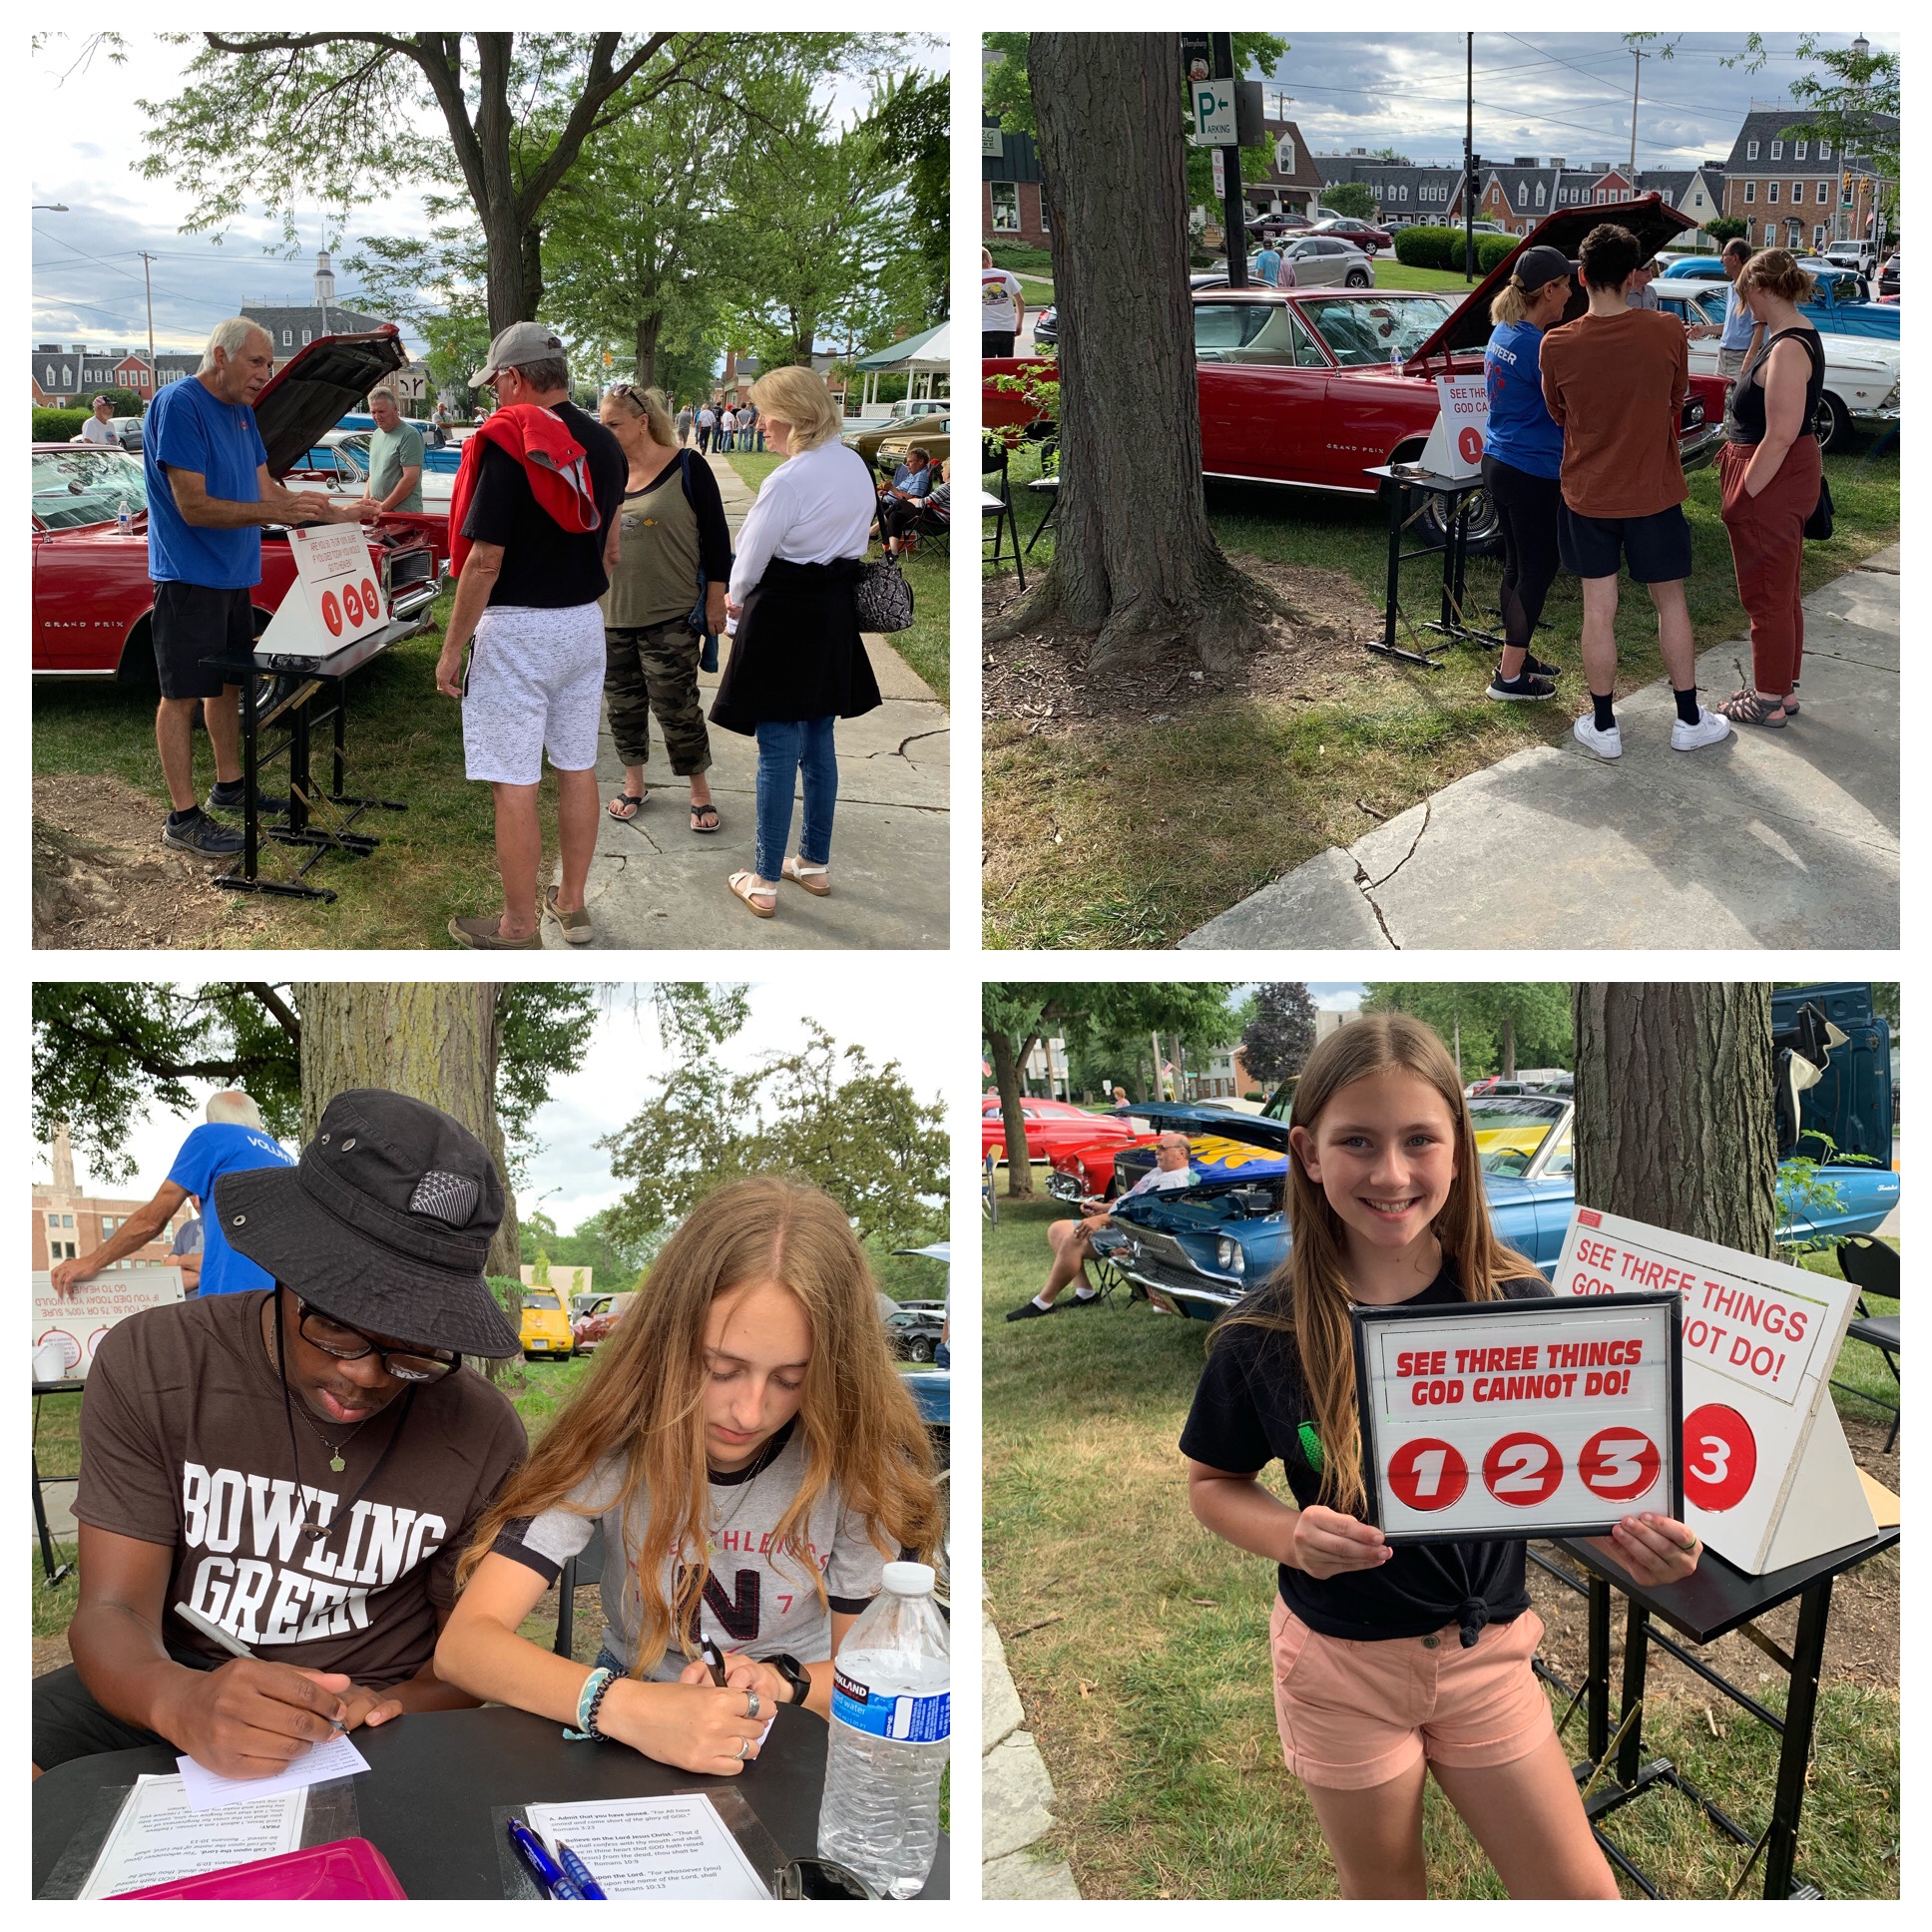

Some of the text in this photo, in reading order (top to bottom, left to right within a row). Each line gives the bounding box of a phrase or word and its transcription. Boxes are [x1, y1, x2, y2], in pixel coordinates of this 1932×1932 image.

[1450, 388, 1467, 399] SEE
[1469, 387, 1487, 398] THR
[1454, 403, 1473, 413] GOD
[1327, 443, 1357, 451] GRAND
[1467, 437, 1477, 455] 1
[329, 590, 376, 624] 1 2 3
[247, 1135, 298, 1166] VOLUNT
[114, 1284, 127, 1292] GO
[1576, 1238, 1808, 1343] SEE THREE THINGS
[41, 1309, 63, 1317] SURE
[65, 1308, 85, 1317] 100%
[1396, 1340, 1643, 1377] SEE THREE THINGS
[1729, 1336, 1786, 1382] DO!
[1412, 1369, 1631, 1406] GOD CANNOT DO!
[1411, 1439, 1649, 1496] 1 2 3
[1689, 1435, 1731, 1484] 3
[183, 1460, 447, 1585] BOWLING
[188, 1555, 389, 1645] GREEN
[677, 1564, 759, 1643] N
[777, 1595, 793, 1614] 7
[844, 1700, 866, 1715] water
